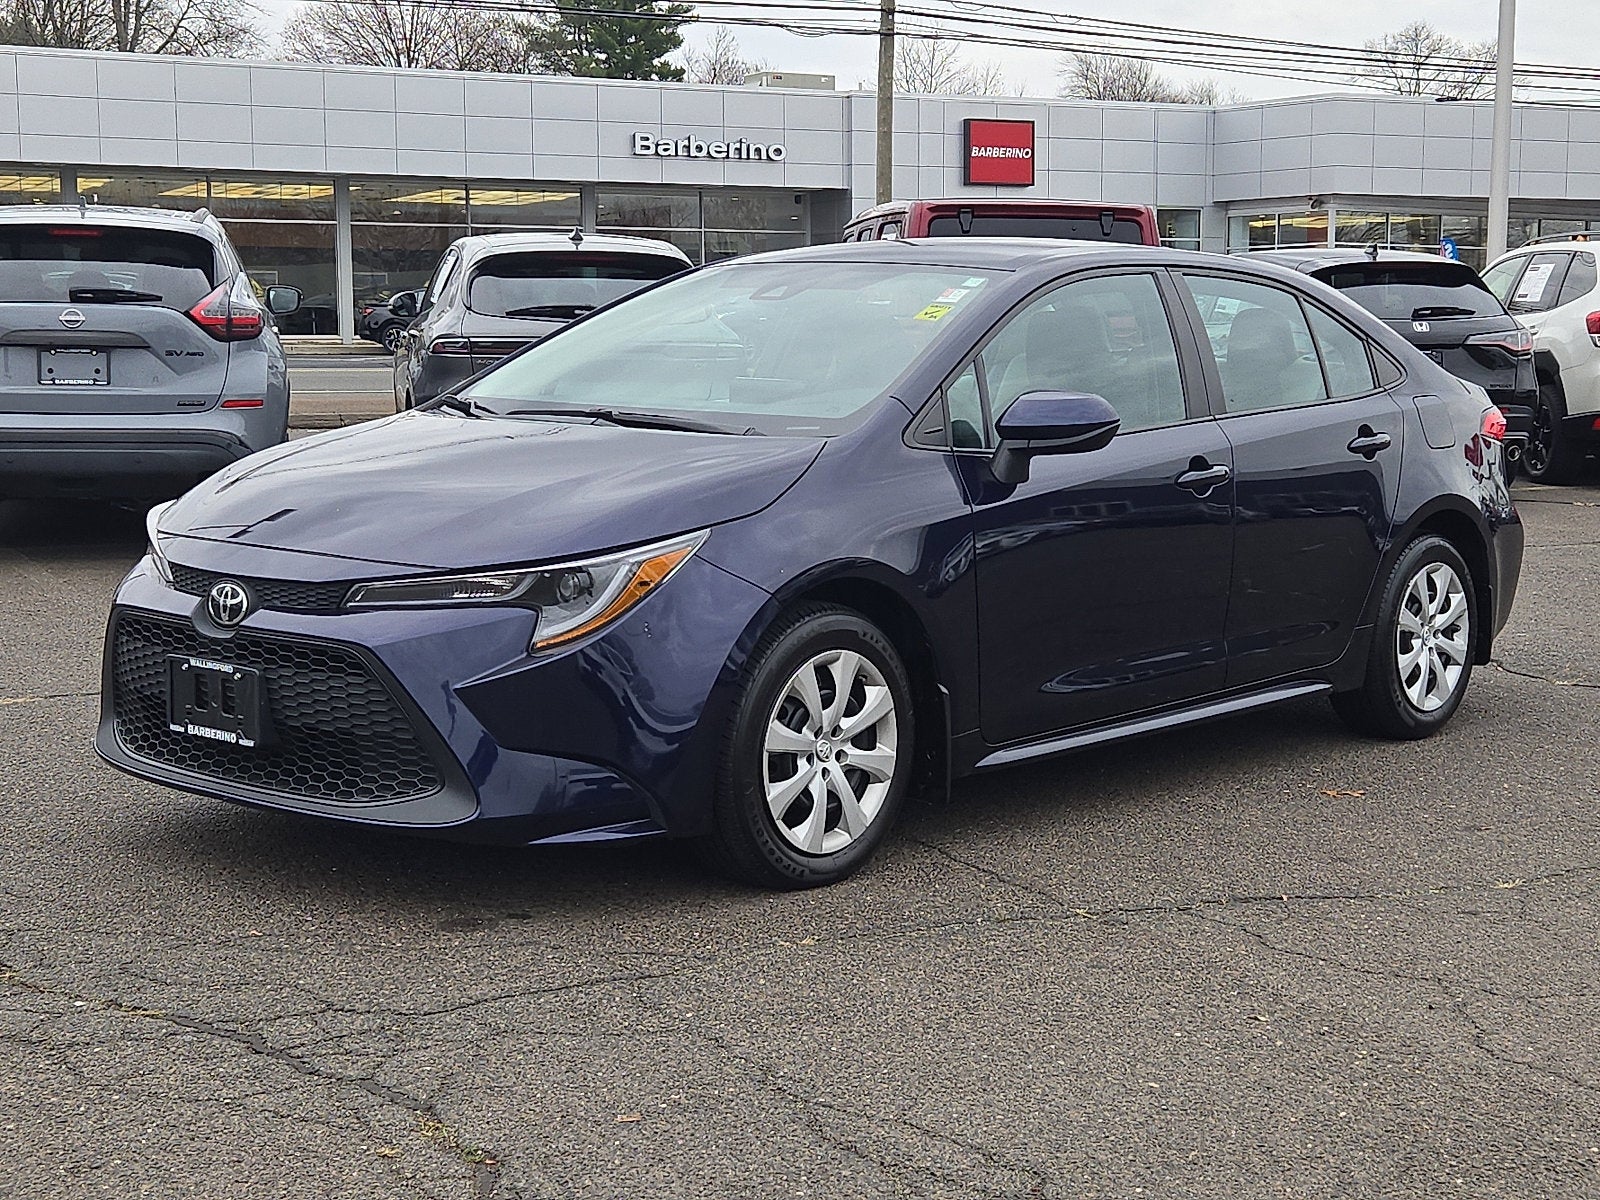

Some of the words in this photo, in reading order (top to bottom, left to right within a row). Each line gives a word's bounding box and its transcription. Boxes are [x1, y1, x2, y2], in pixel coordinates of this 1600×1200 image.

[633, 131, 787, 162] Barberino
[971, 146, 1033, 159] BARBERINO
[165, 349, 183, 357] SV
[187, 724, 236, 743] BARBERINO
